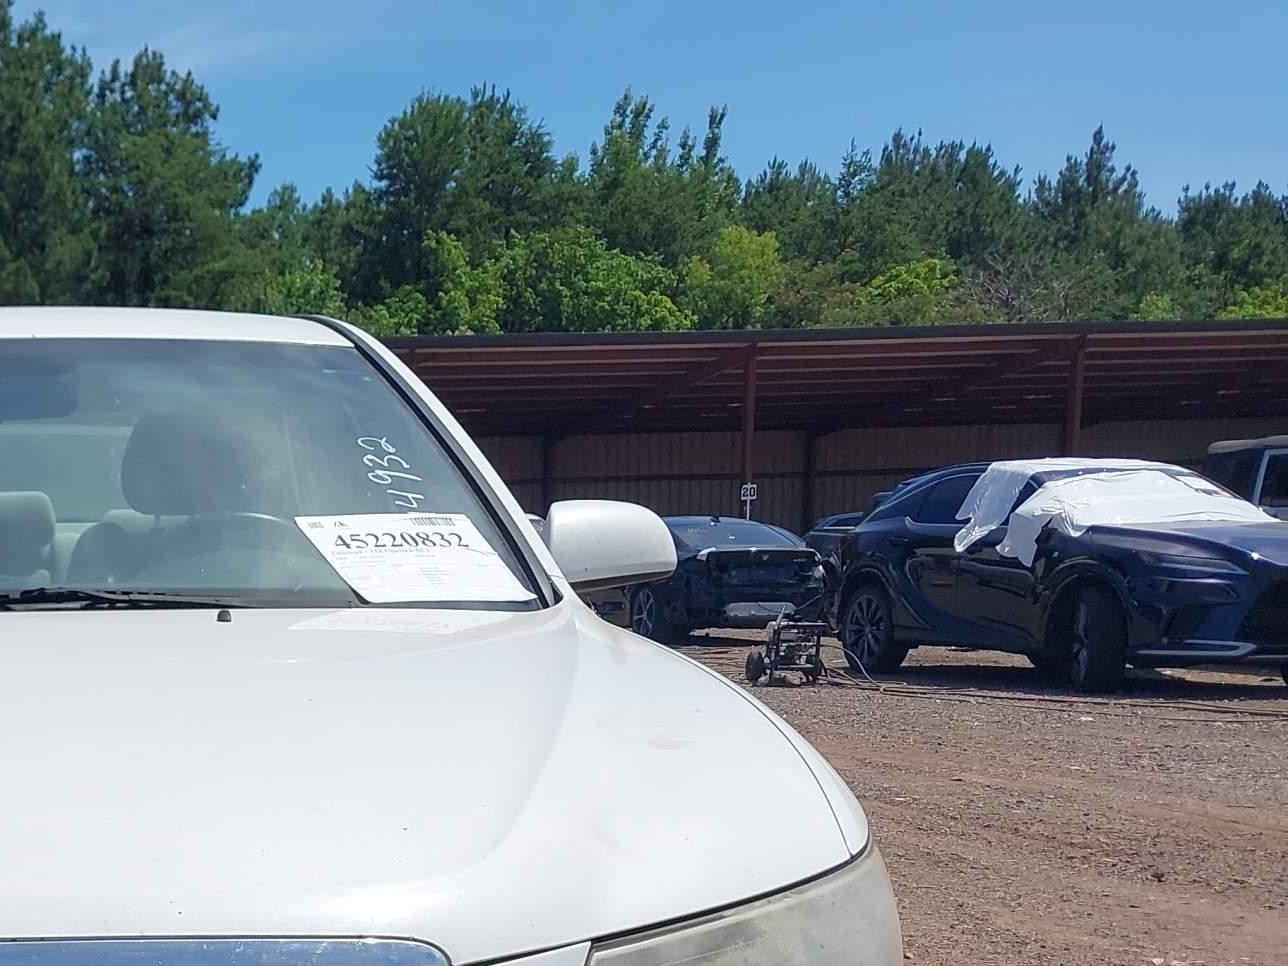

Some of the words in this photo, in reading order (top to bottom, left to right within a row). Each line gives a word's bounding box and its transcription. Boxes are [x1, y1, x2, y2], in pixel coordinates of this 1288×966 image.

[357, 436, 425, 508] 4932
[742, 486, 756, 497] 20
[334, 531, 470, 549] 45220832
